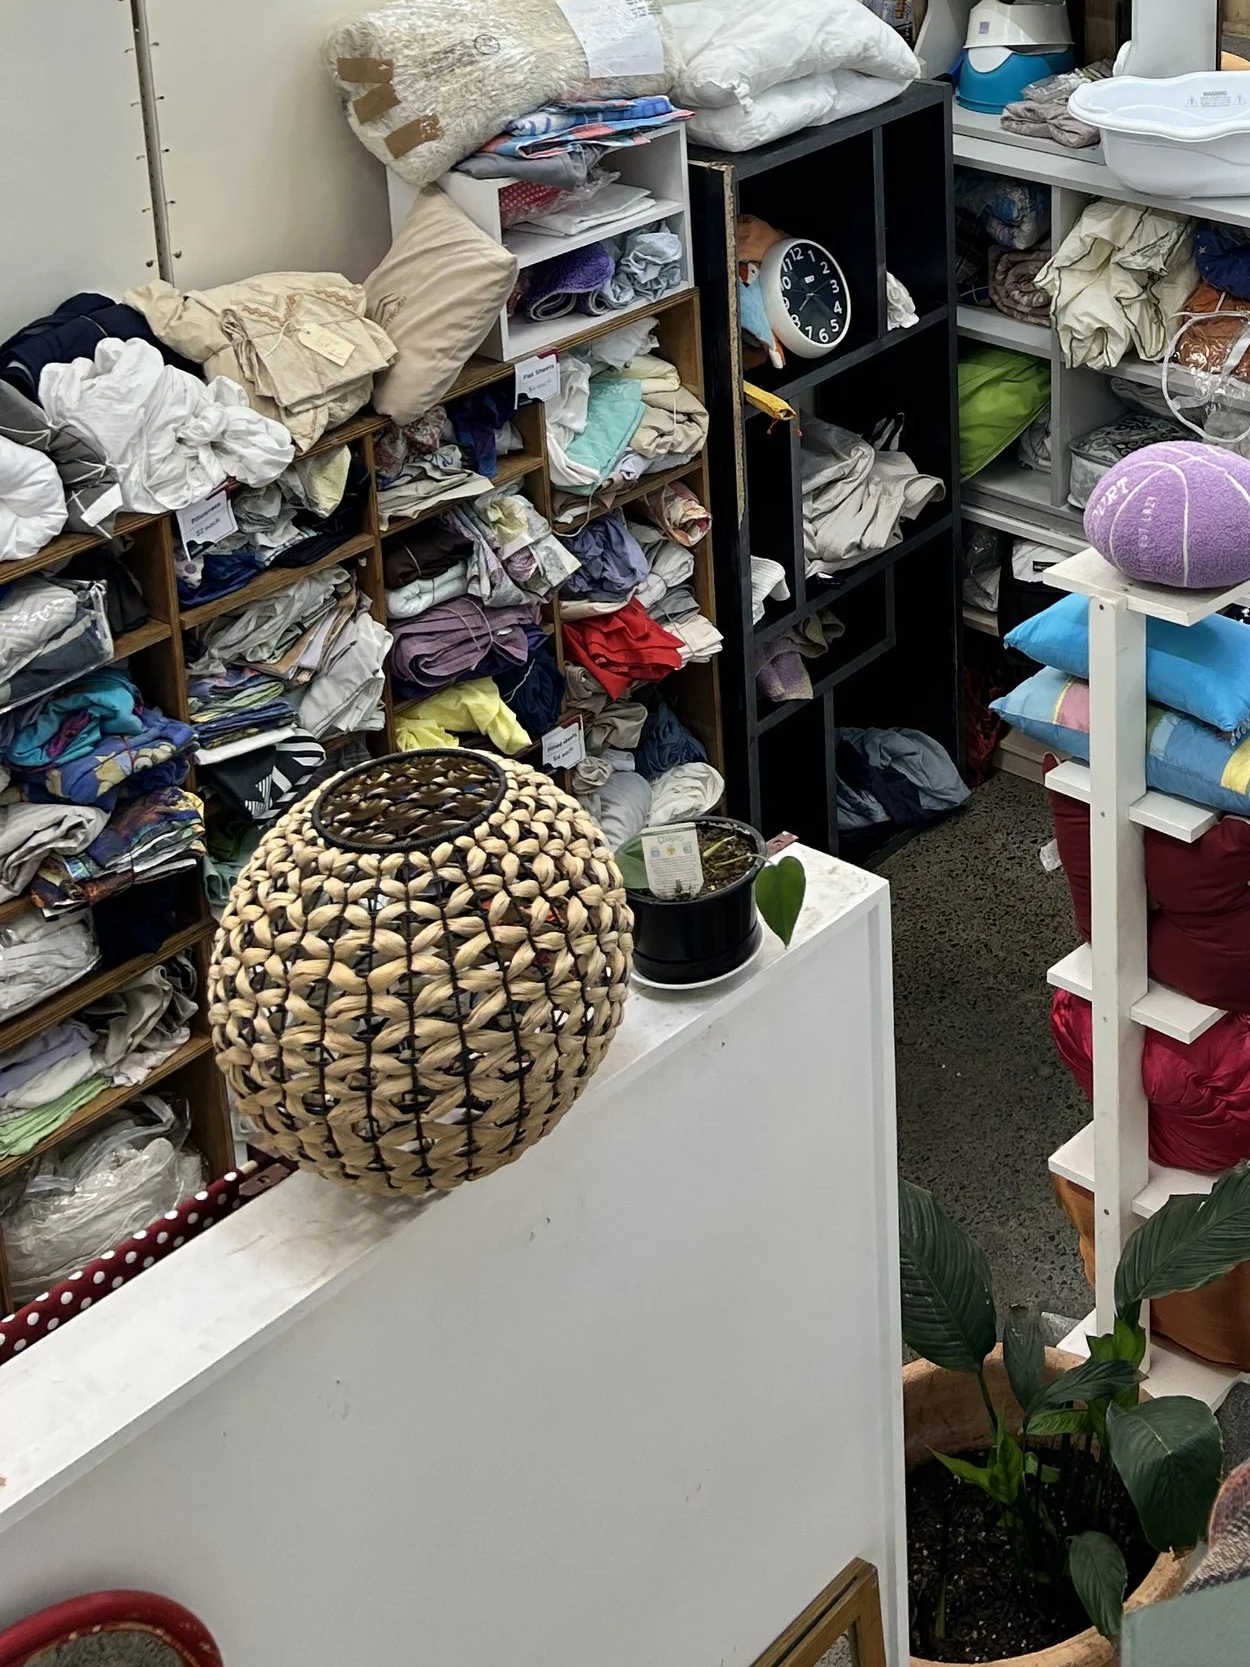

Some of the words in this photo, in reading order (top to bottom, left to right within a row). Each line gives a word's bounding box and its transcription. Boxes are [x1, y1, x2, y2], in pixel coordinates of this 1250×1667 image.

[789, 247, 805, 261] 12
[807, 250, 815, 263] 1
[782, 258, 794, 272] 11
[820, 261, 830, 274] 2
[781, 276, 792, 291] 0
[830, 279, 839, 293] 3
[834, 301, 842, 314] 4
[830, 319, 839, 332] 5
[805, 326, 813, 339] 7
[819, 328, 829, 342] 6
